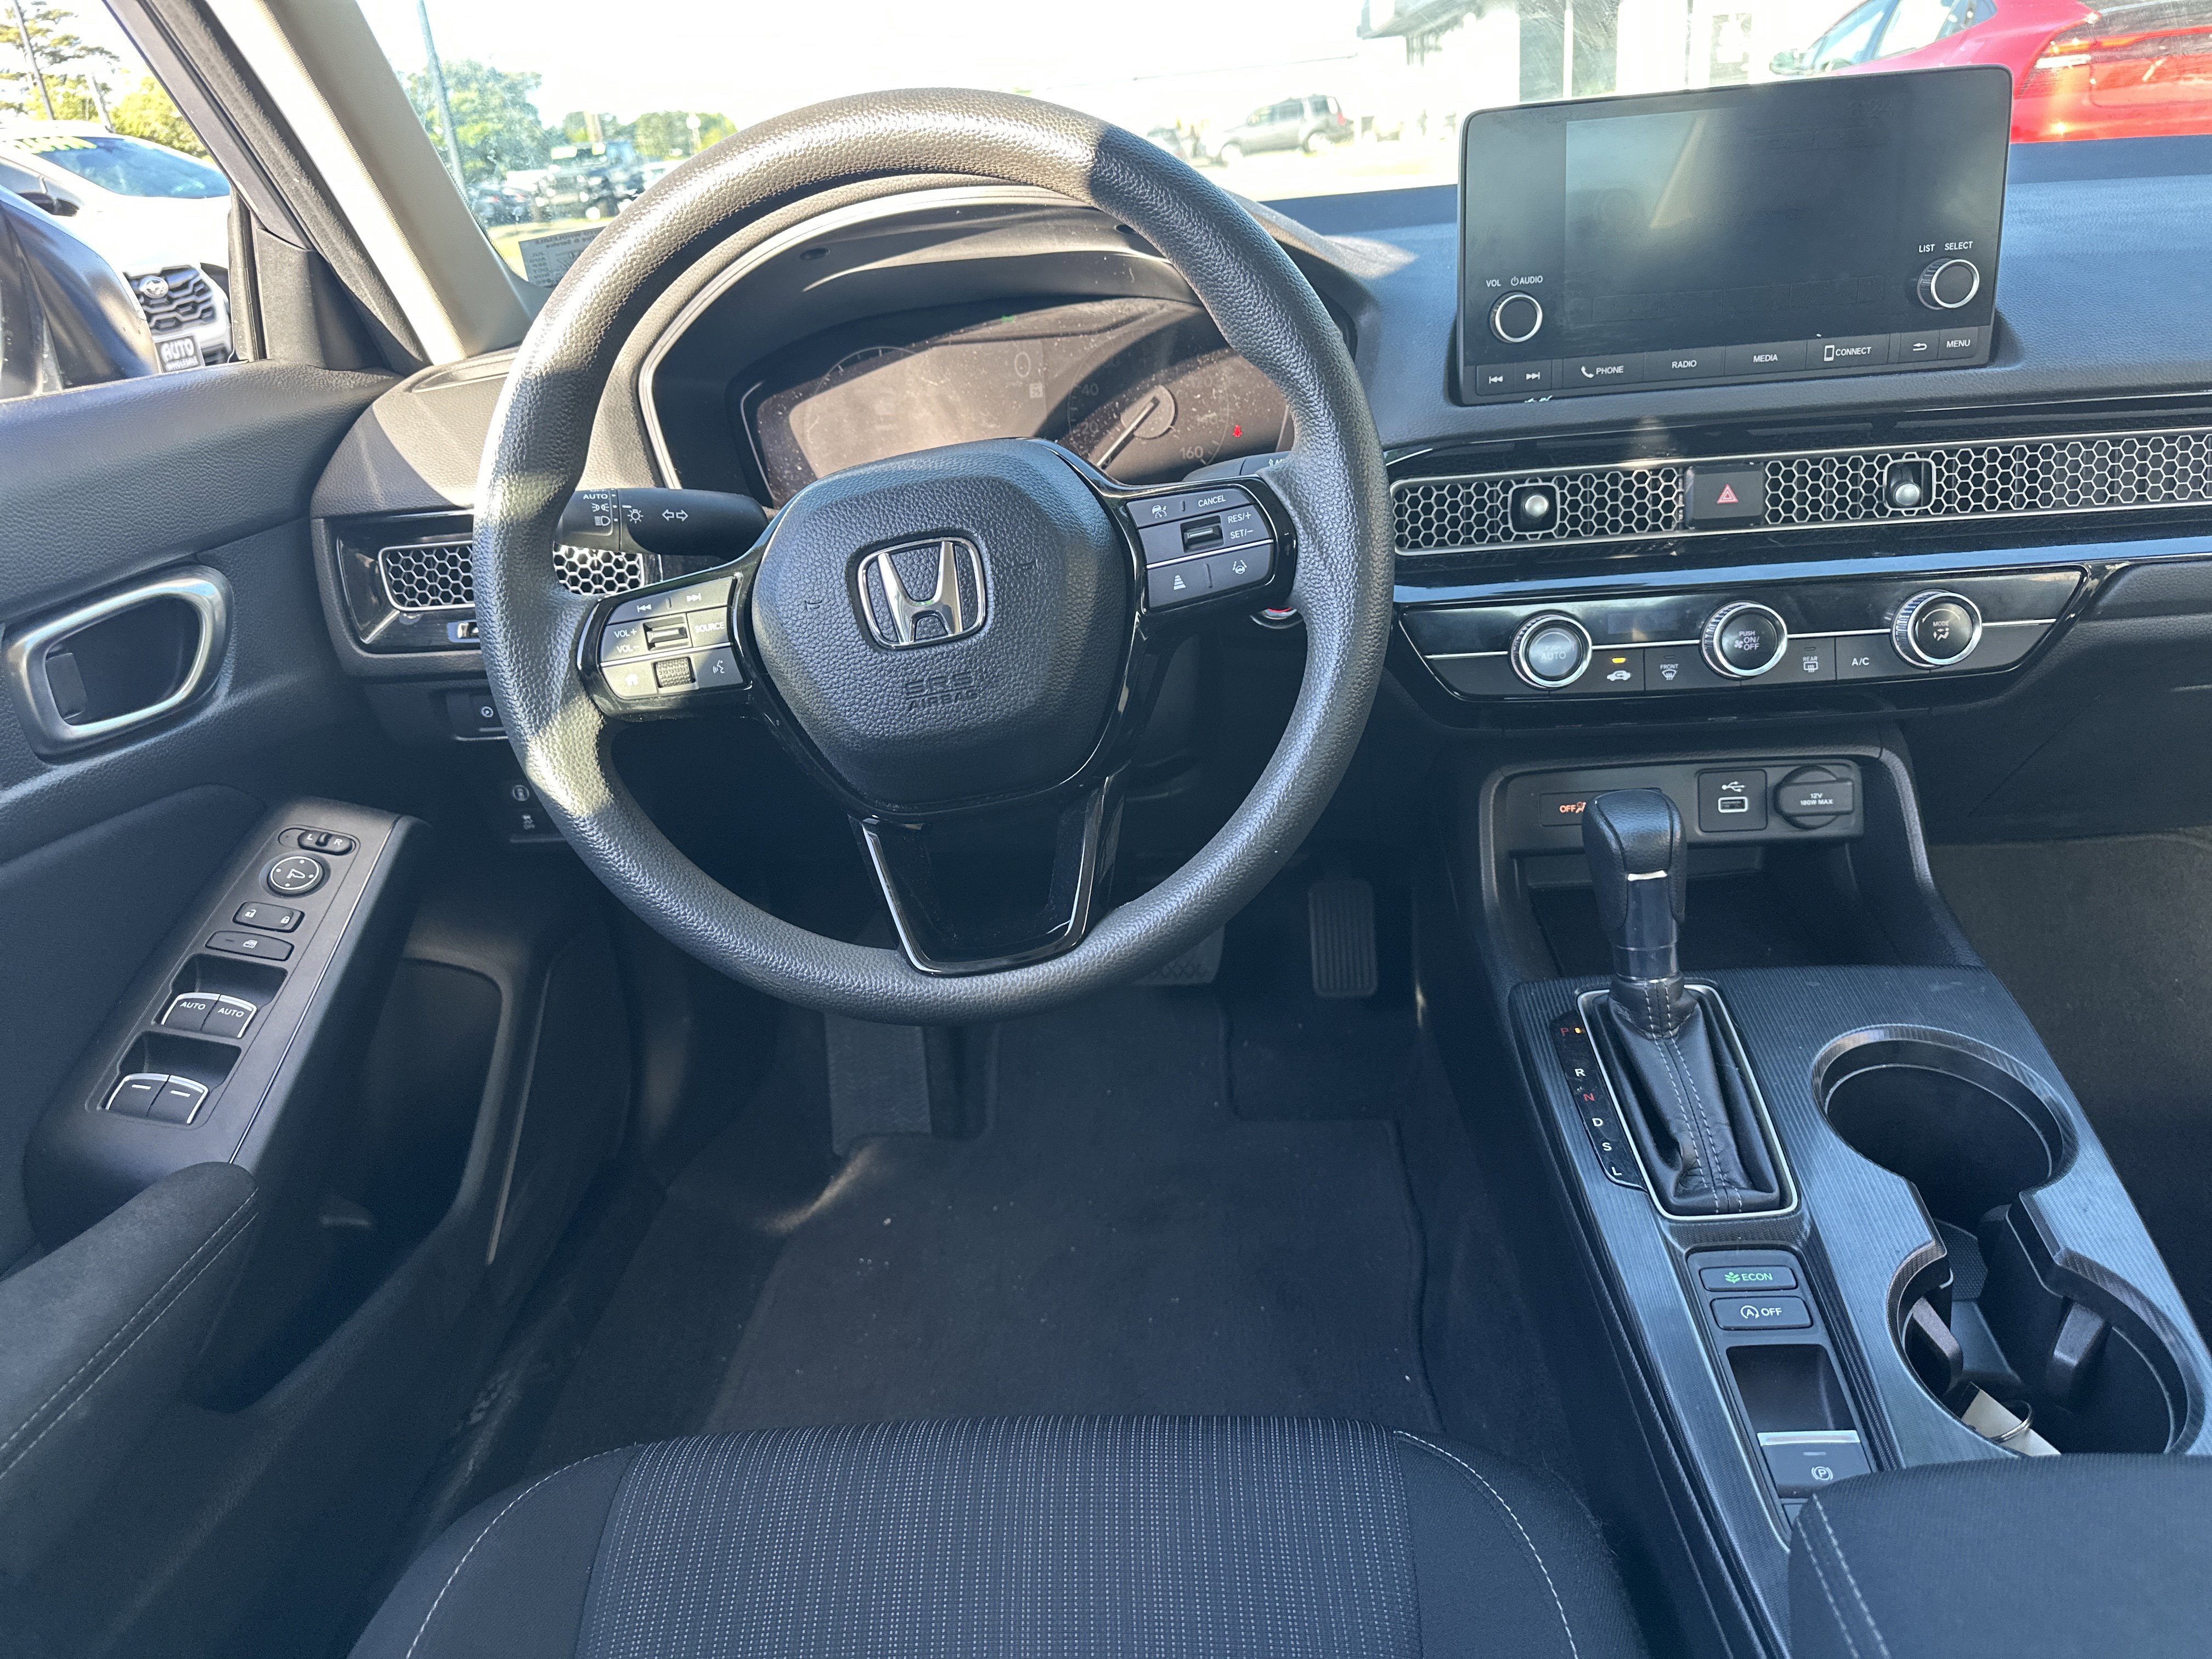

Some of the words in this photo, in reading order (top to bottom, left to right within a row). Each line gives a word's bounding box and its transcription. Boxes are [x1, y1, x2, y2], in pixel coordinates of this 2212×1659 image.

[1918, 244, 1936, 252] LIST
[1944, 241, 1973, 251] SELECT
[1486, 279, 1502, 287] VOL
[1519, 275, 1543, 285] AUDIO
[1946, 339, 1971, 348] MENU
[161, 338, 194, 362] AUTO
[1835, 346, 1872, 357] CONNECT
[1753, 354, 1779, 363] MEDIA
[1671, 359, 1697, 369] RADIO
[1596, 365, 1624, 375] PHONE
[1080, 383, 1099, 397] 40
[1081, 421, 1099, 434] 20
[1180, 445, 1204, 460] 160
[1198, 495, 1226, 507] CANCEL
[694, 620, 725, 633] SOURCE
[1540, 651, 1566, 661] AUTO
[1852, 657, 1870, 666] A/C
[1559, 804, 1576, 813] OFF
[179, 1001, 206, 1010] AUTO
[217, 1007, 245, 1018] AUTO
[1560, 1028, 1569, 1036] P
[1575, 1068, 1585, 1077] R
[1583, 1093, 1595, 1102] N
[1592, 1117, 1604, 1127] D
[1602, 1142, 1612, 1151] S
[1611, 1166, 1622, 1176] L
[1741, 1272, 1774, 1282] ECON
[1760, 1307, 1782, 1316] OFF
